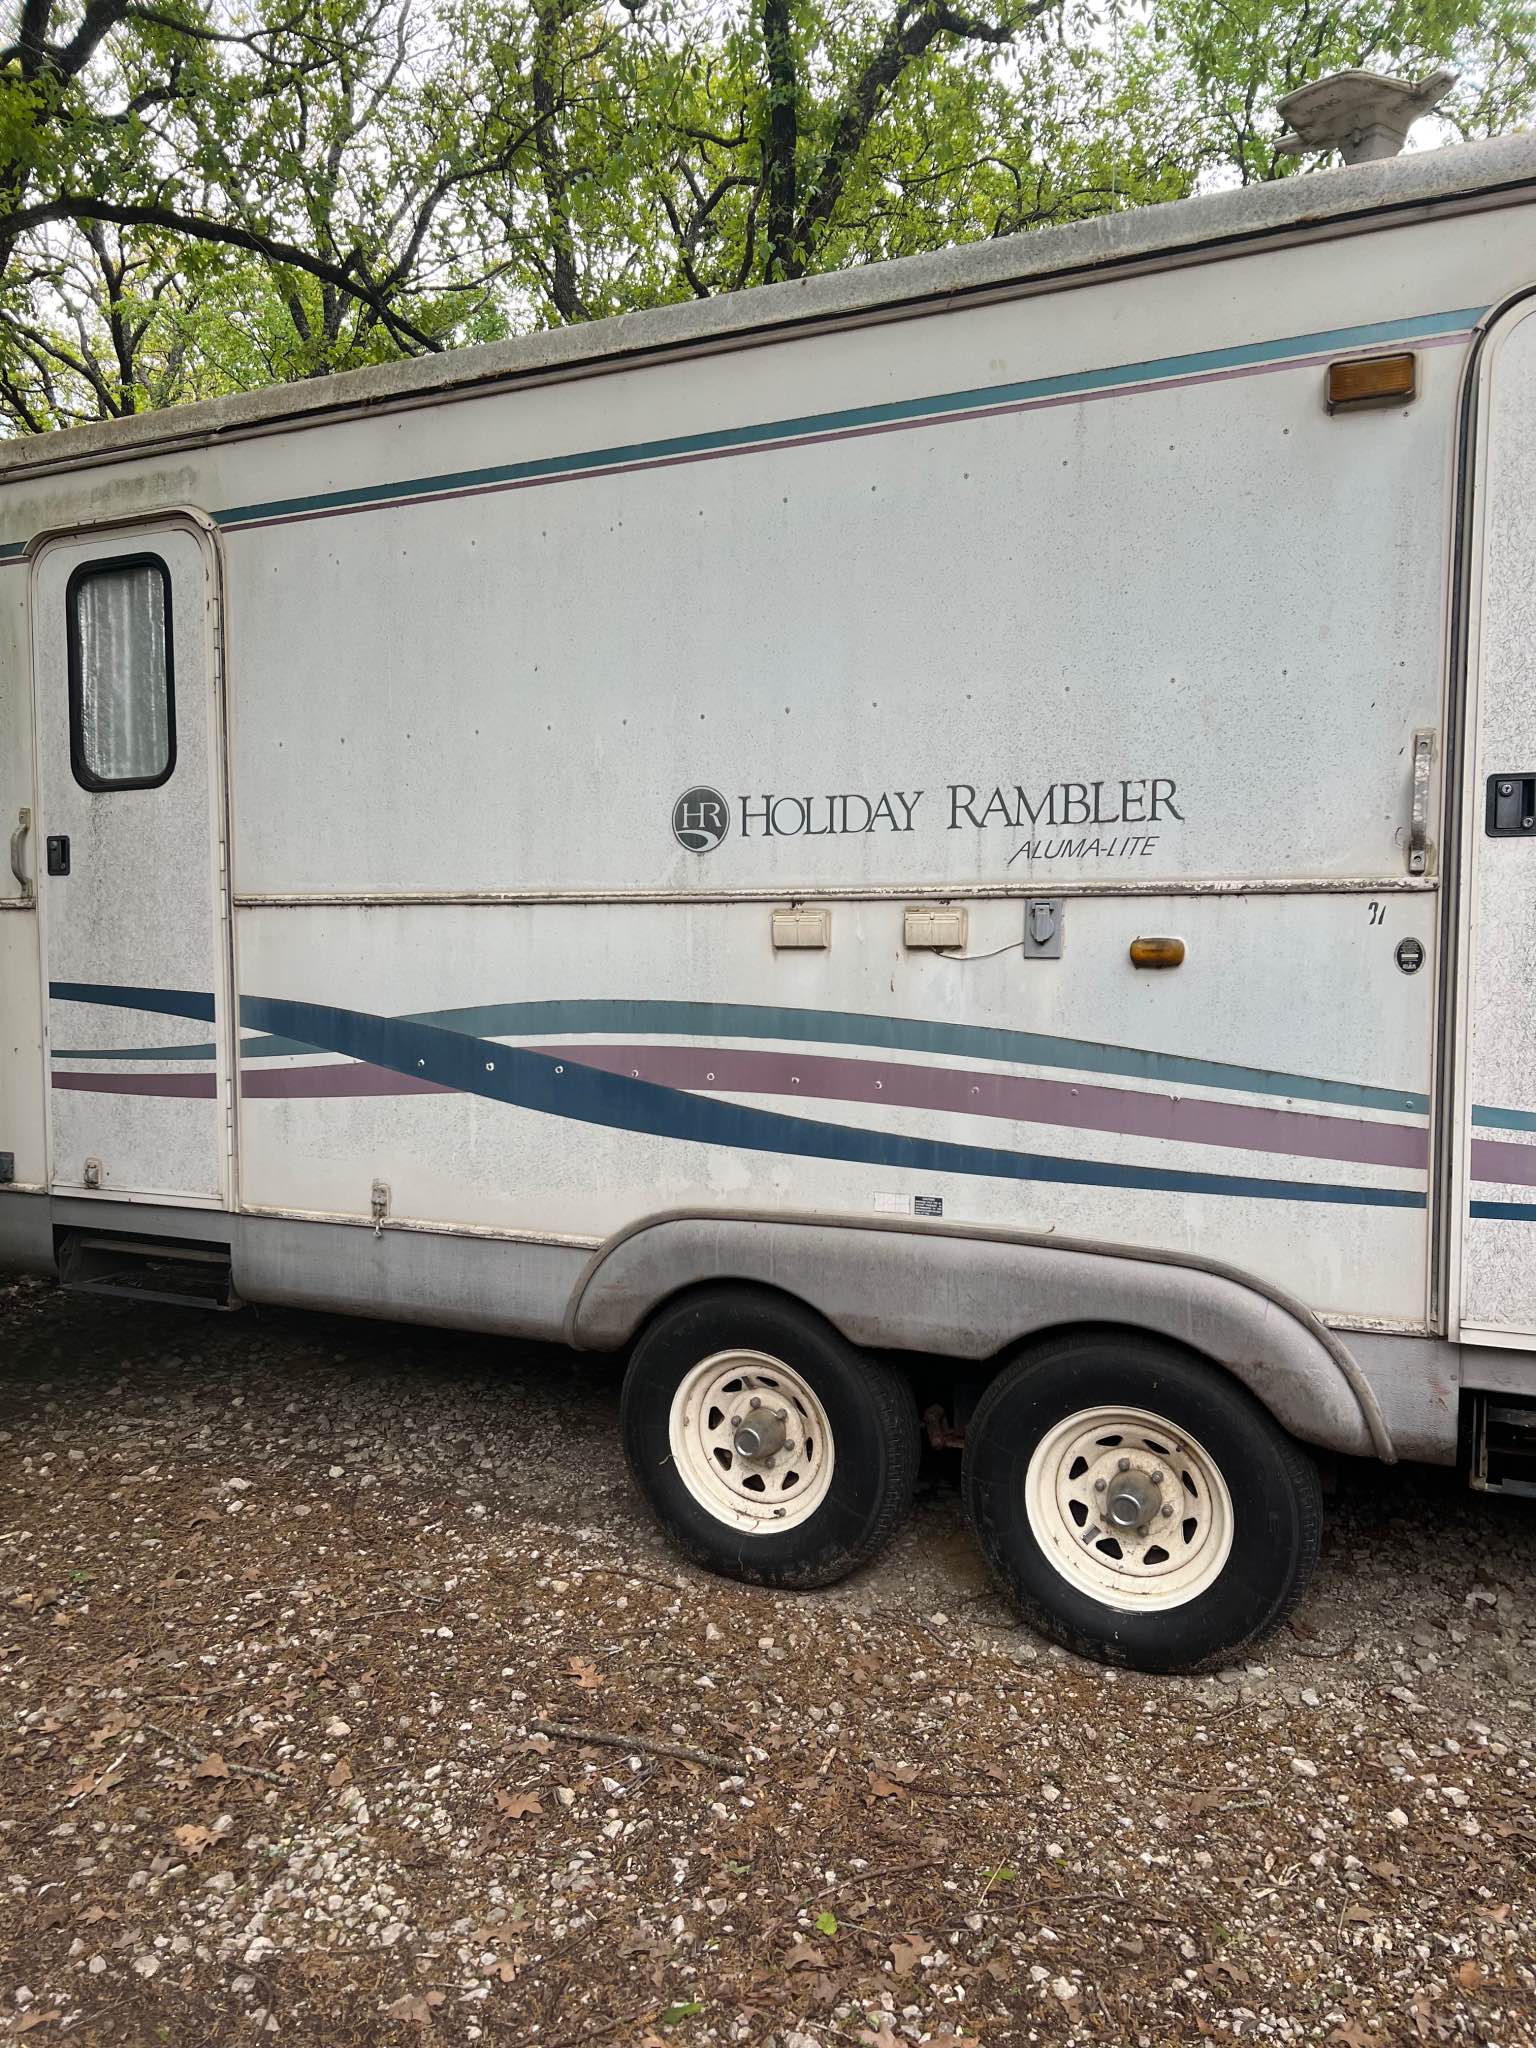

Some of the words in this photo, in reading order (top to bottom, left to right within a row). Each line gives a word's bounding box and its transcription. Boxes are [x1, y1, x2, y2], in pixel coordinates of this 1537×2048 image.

[682, 802, 722, 828] HR
[738, 790, 925, 837] HOLIDAY
[946, 778, 1185, 830] RAMBLER
[1007, 836, 1161, 865] ALUMA-LITE
